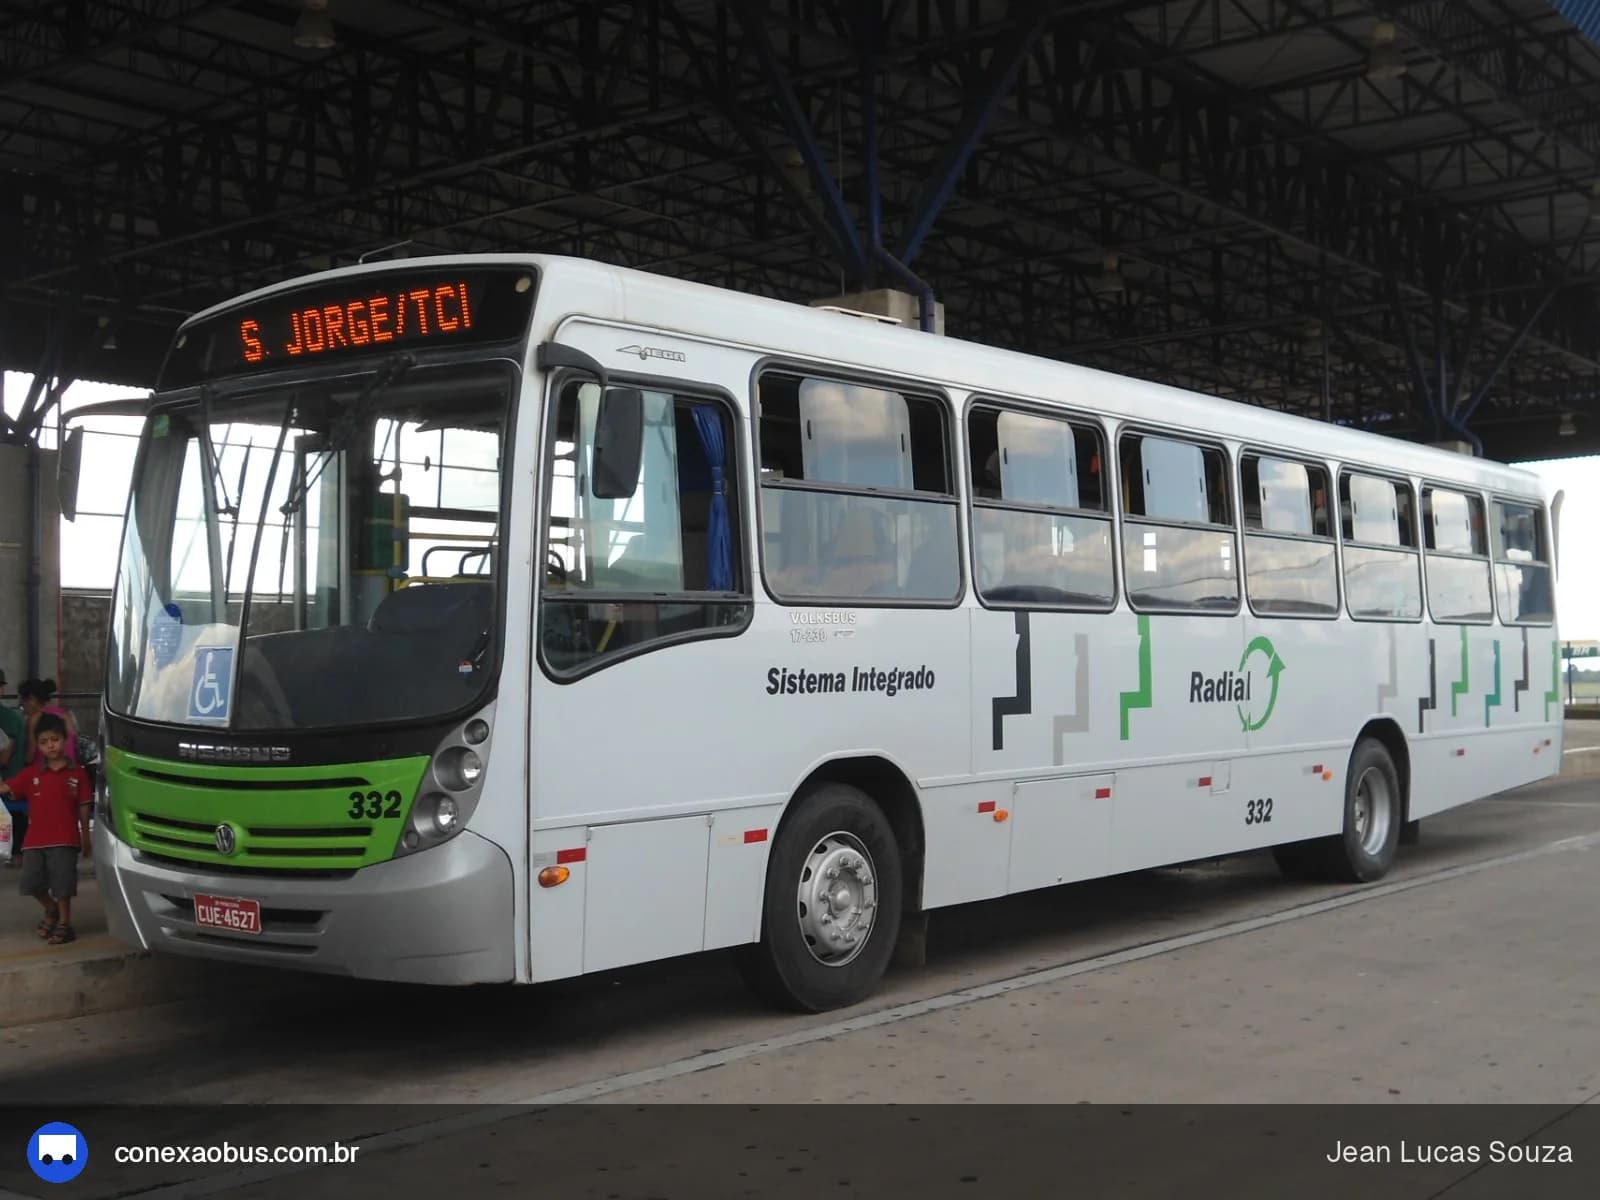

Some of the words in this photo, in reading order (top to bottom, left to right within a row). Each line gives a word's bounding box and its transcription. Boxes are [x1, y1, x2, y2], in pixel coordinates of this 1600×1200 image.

[286, 282, 471, 354] JORGE/TCI
[790, 611, 856, 625] VOLKSBUS
[766, 666, 846, 695] Sistema
[851, 664, 935, 697] Integrado
[1190, 670, 1250, 703] Radial
[348, 791, 402, 819] 332
[1245, 798, 1273, 825] 332
[198, 904, 256, 930] CUE-4627
